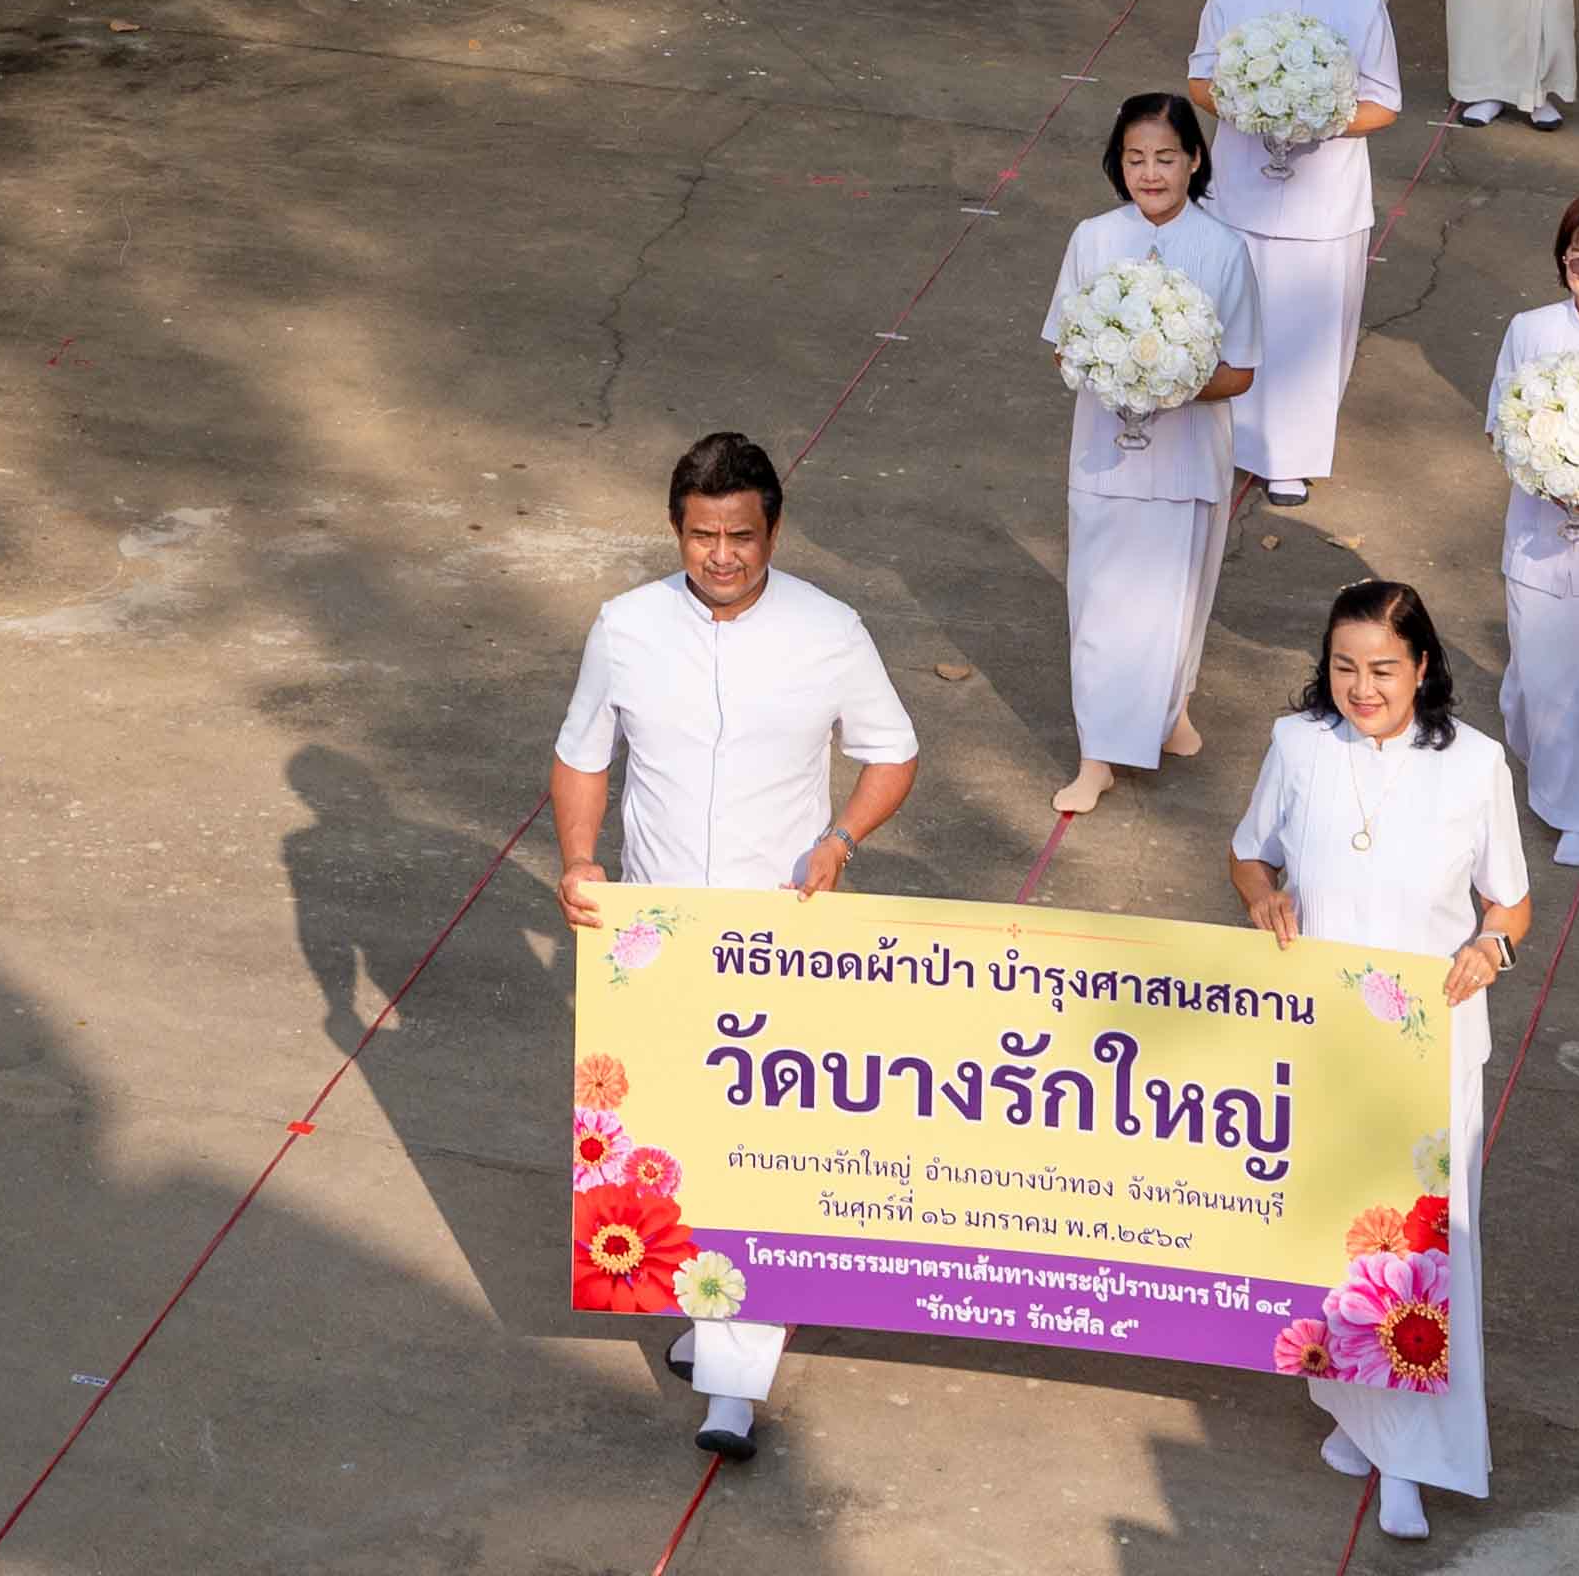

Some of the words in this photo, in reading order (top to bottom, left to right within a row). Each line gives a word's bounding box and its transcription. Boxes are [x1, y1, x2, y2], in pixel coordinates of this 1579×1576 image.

[712, 931, 974, 988] พิธีทอดผ้าป่า
[988, 948, 1315, 1025] บำรุงศาสนสถาน
[705, 1013, 1291, 1182] วัดบางรักใหญ่
[728, 1149, 910, 1186] ตำบลบางรักใหญ่
[926, 1164, 1114, 1197] อำเภอบางบัวทอง
[1128, 1178, 1284, 1225] จังหวัดนนทบุรี
[819, 1189, 913, 1227] วันศุกร์ที่
[921, 1208, 957, 1225] ๑๖
[967, 1211, 1057, 1235] มกราคม
[1067, 1220, 1193, 1249] พ.ศ.๒๕๖๙
[745, 1240, 1210, 1306] โครงการธรรมยาตราเส้นทางพระผู้ปราบมาร
[1213, 1278, 1251, 1311] ปีที่
[1255, 1298, 1292, 1317] ๑๔
[916, 1293, 1017, 1327] "รักษ์บวร
[1026, 1303, 1105, 1336] รักษ์ศีล
